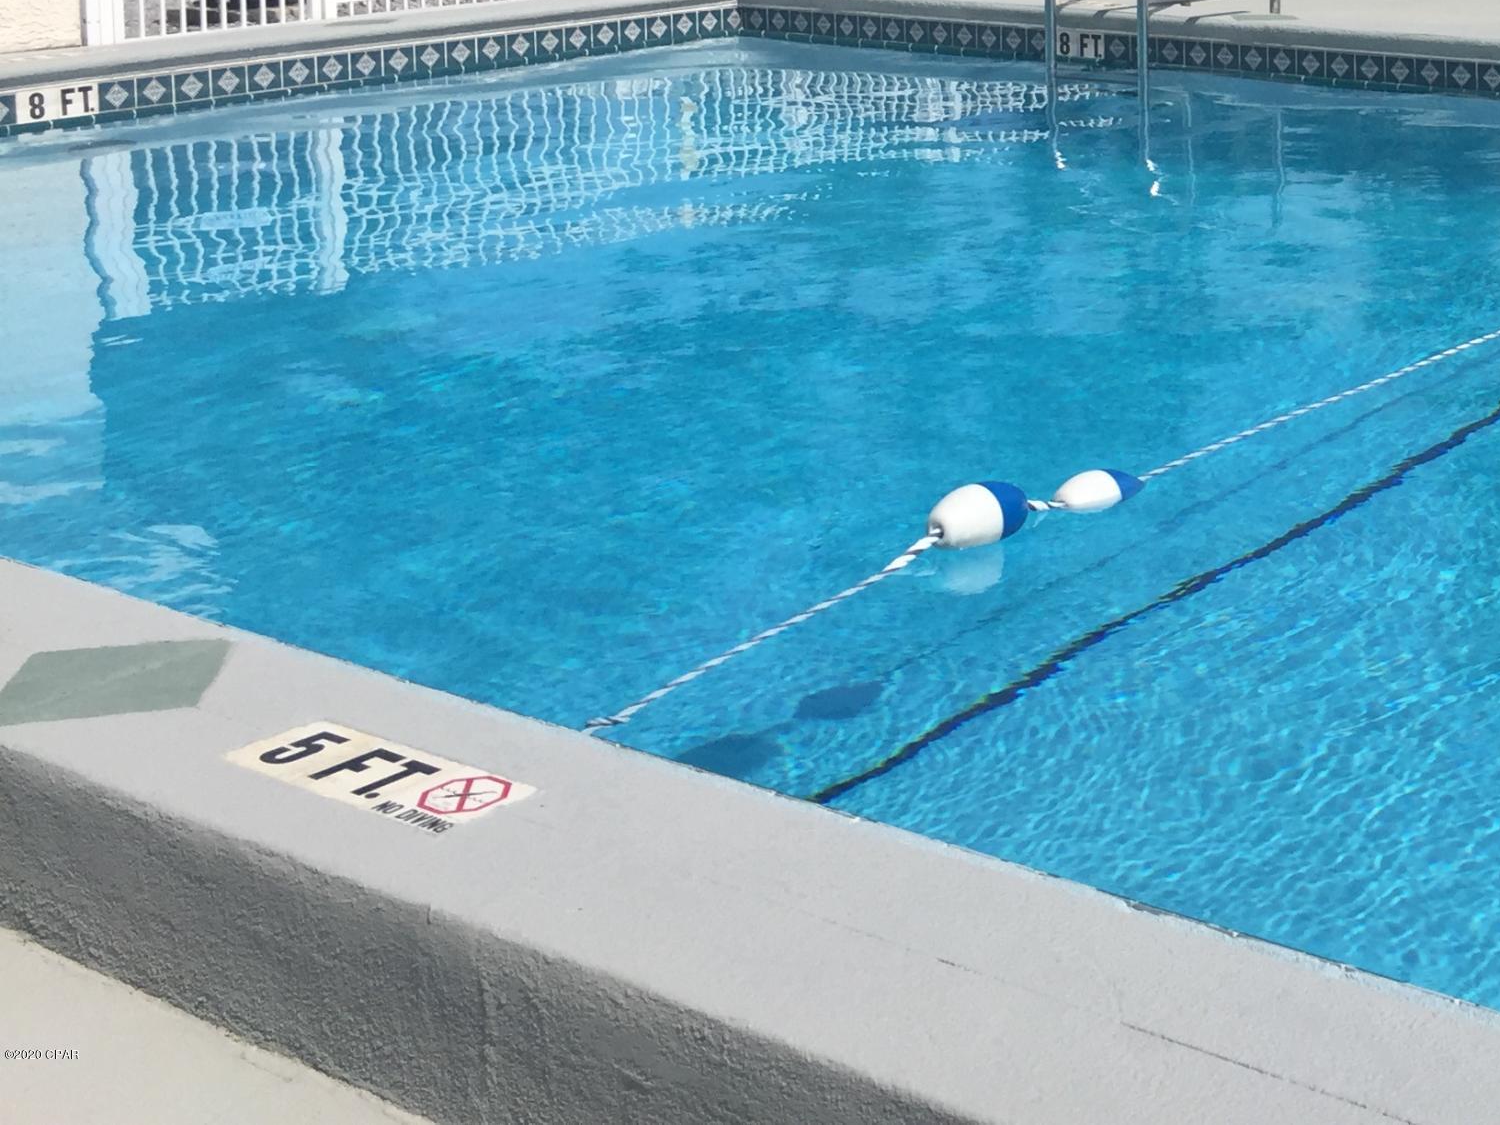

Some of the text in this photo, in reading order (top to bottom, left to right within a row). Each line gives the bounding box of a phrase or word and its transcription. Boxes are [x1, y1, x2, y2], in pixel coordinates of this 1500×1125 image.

[1060, 32, 1103, 58] 8 FT.
[29, 85, 95, 120] 8 FT.
[259, 731, 442, 800] 5 FT.
[371, 800, 455, 834] NO DIVING
